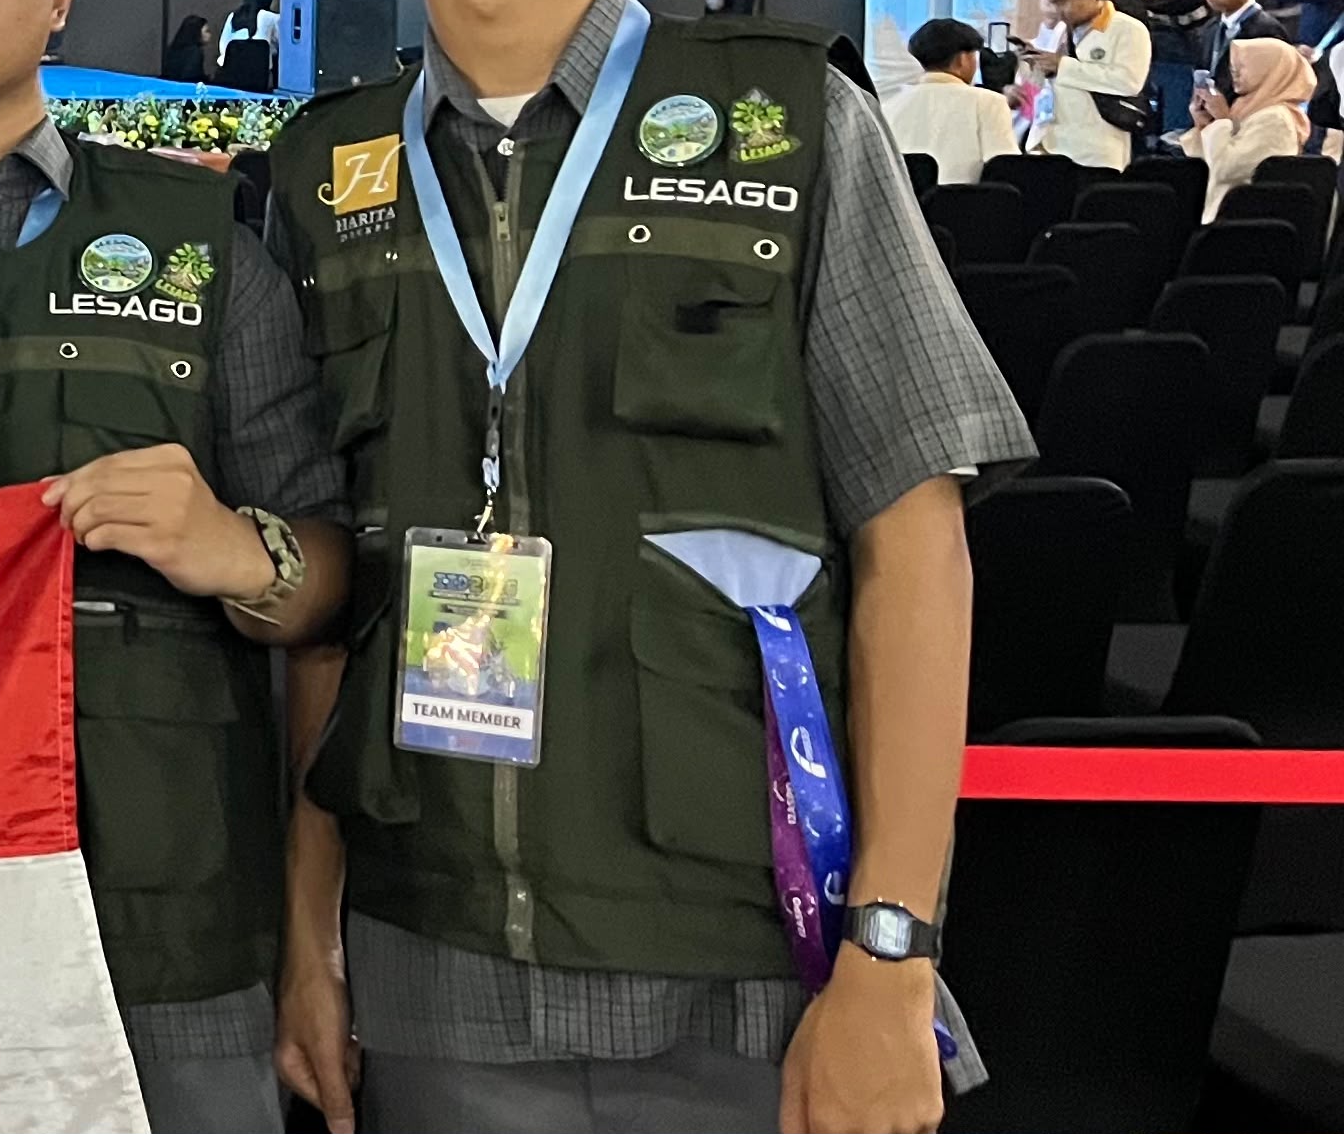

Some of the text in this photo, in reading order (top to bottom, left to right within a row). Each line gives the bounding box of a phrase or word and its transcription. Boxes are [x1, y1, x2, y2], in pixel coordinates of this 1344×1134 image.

[624, 176, 799, 212] LESAGO
[335, 206, 396, 234] HARITA
[49, 292, 202, 326] LESAGO
[413, 702, 521, 729] TEAM MEMBER
